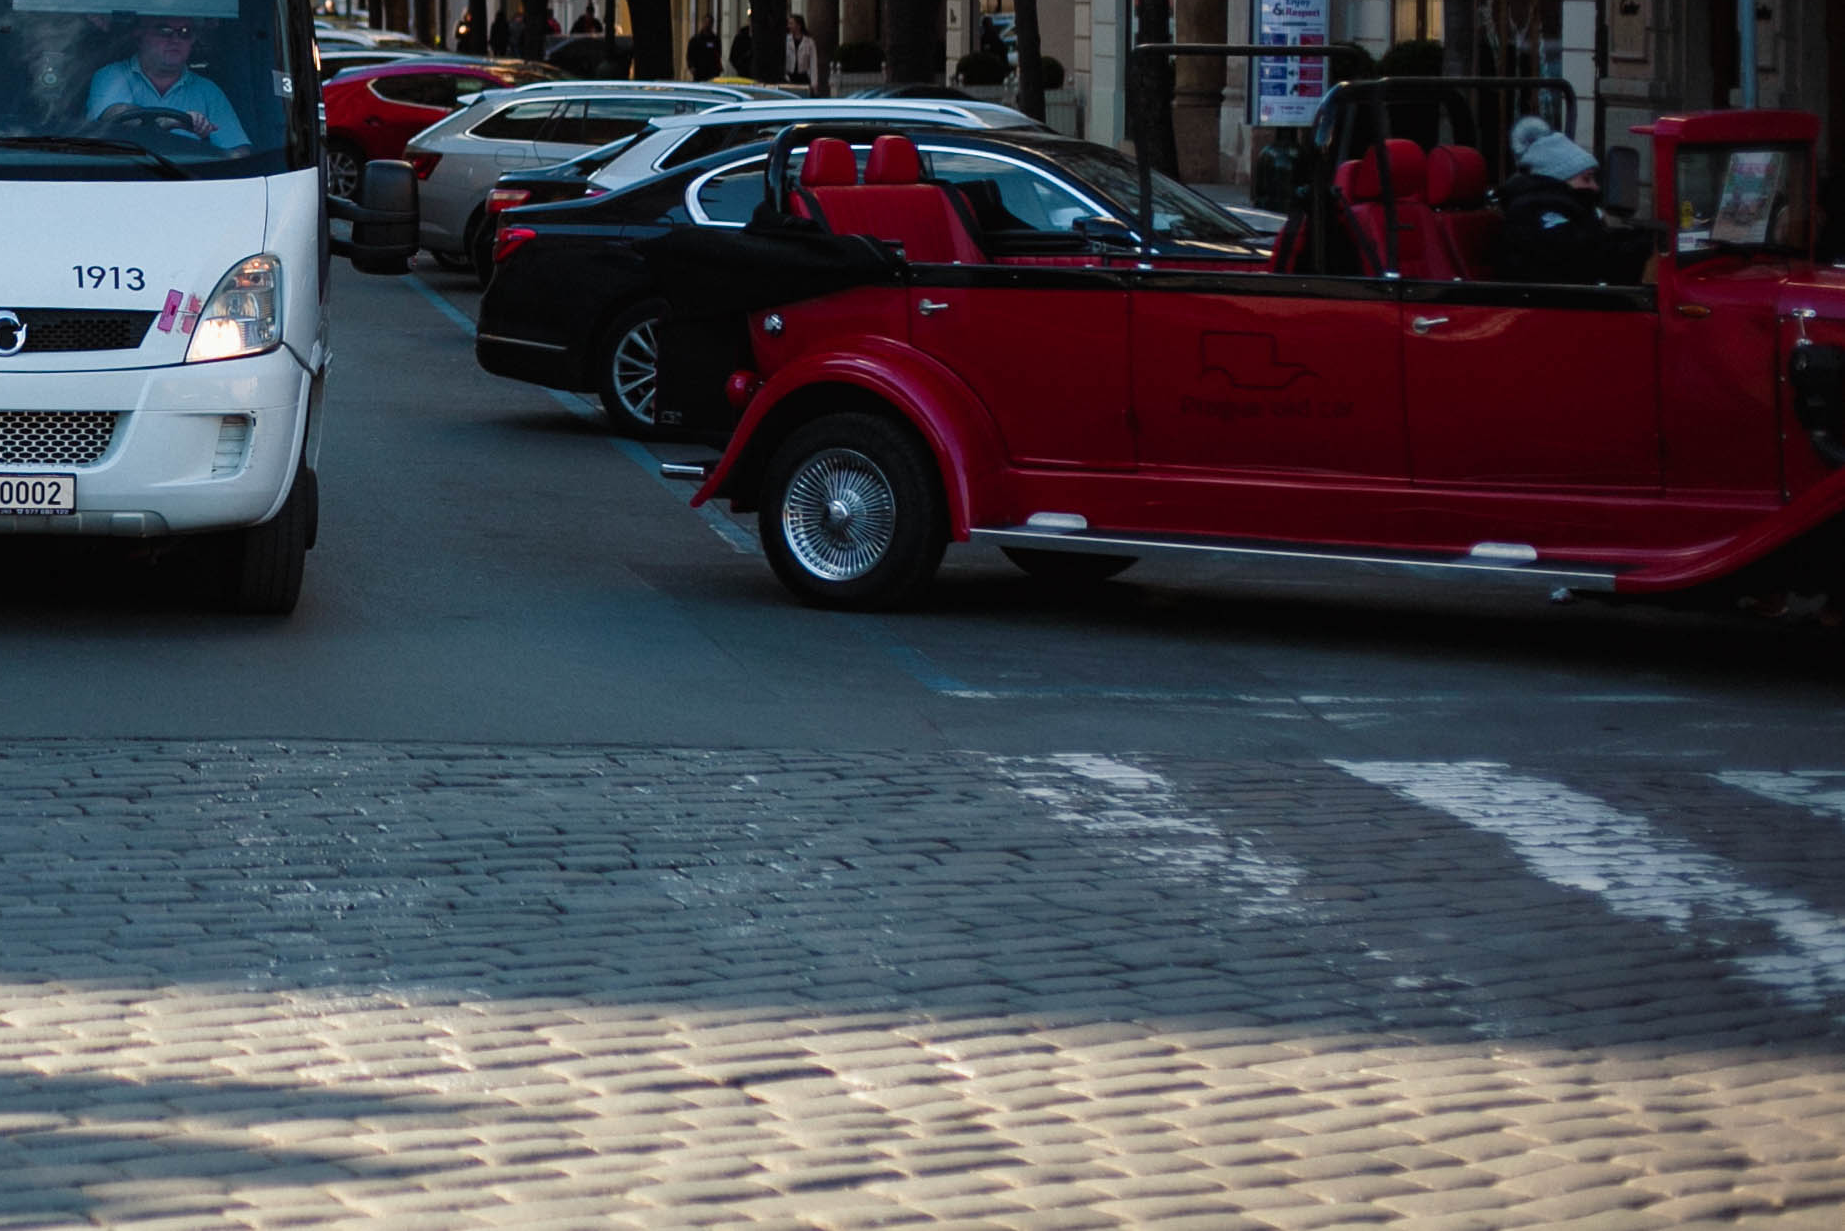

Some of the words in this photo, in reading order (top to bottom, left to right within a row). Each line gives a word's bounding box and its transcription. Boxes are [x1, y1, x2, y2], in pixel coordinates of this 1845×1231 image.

[283, 77, 293, 93] 3
[72, 265, 146, 291] 1913
[0, 481, 62, 505] 0002
